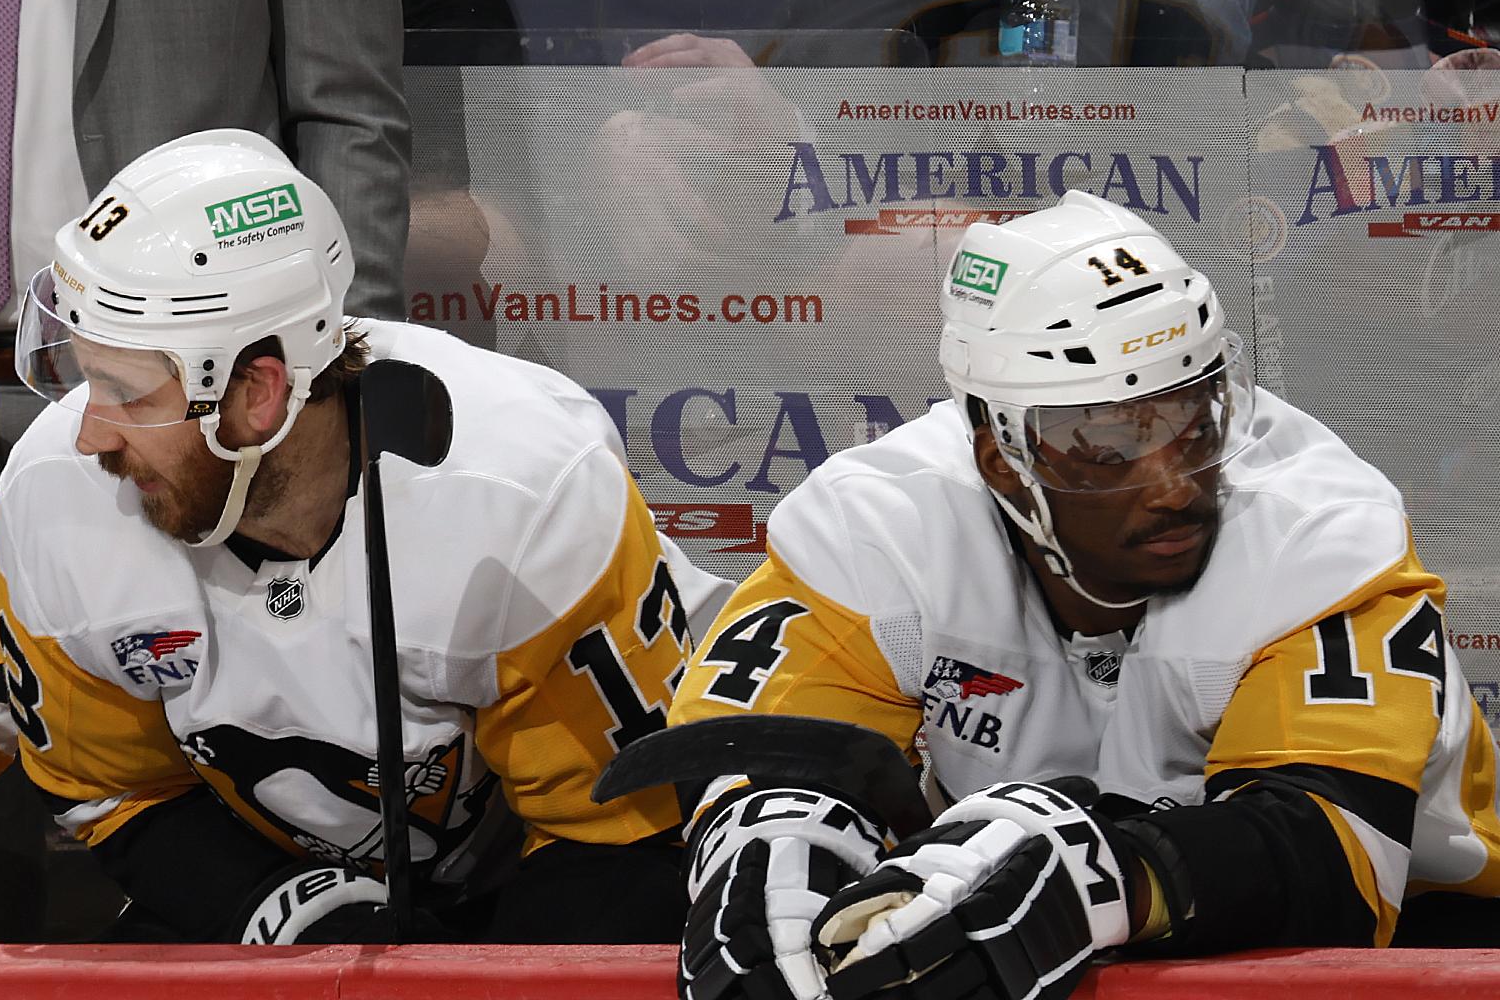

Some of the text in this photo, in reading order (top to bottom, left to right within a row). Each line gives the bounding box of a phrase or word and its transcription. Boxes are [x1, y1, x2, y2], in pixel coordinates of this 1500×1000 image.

[837, 100, 1136, 121] AmericanVanLines.com
[773, 141, 1204, 225] AMERICAN
[78, 195, 130, 242] 13
[209, 186, 301, 237] MSA
[1419, 215, 1493, 227] VAN
[217, 220, 306, 250] The Safety Company
[953, 252, 1006, 294] MSA
[1088, 247, 1149, 287] 14
[410, 285, 823, 323] anVanLines.com
[1121, 322, 1186, 354] CCM
[273, 589, 300, 612] NHL
[989, 782, 1122, 906] CM
